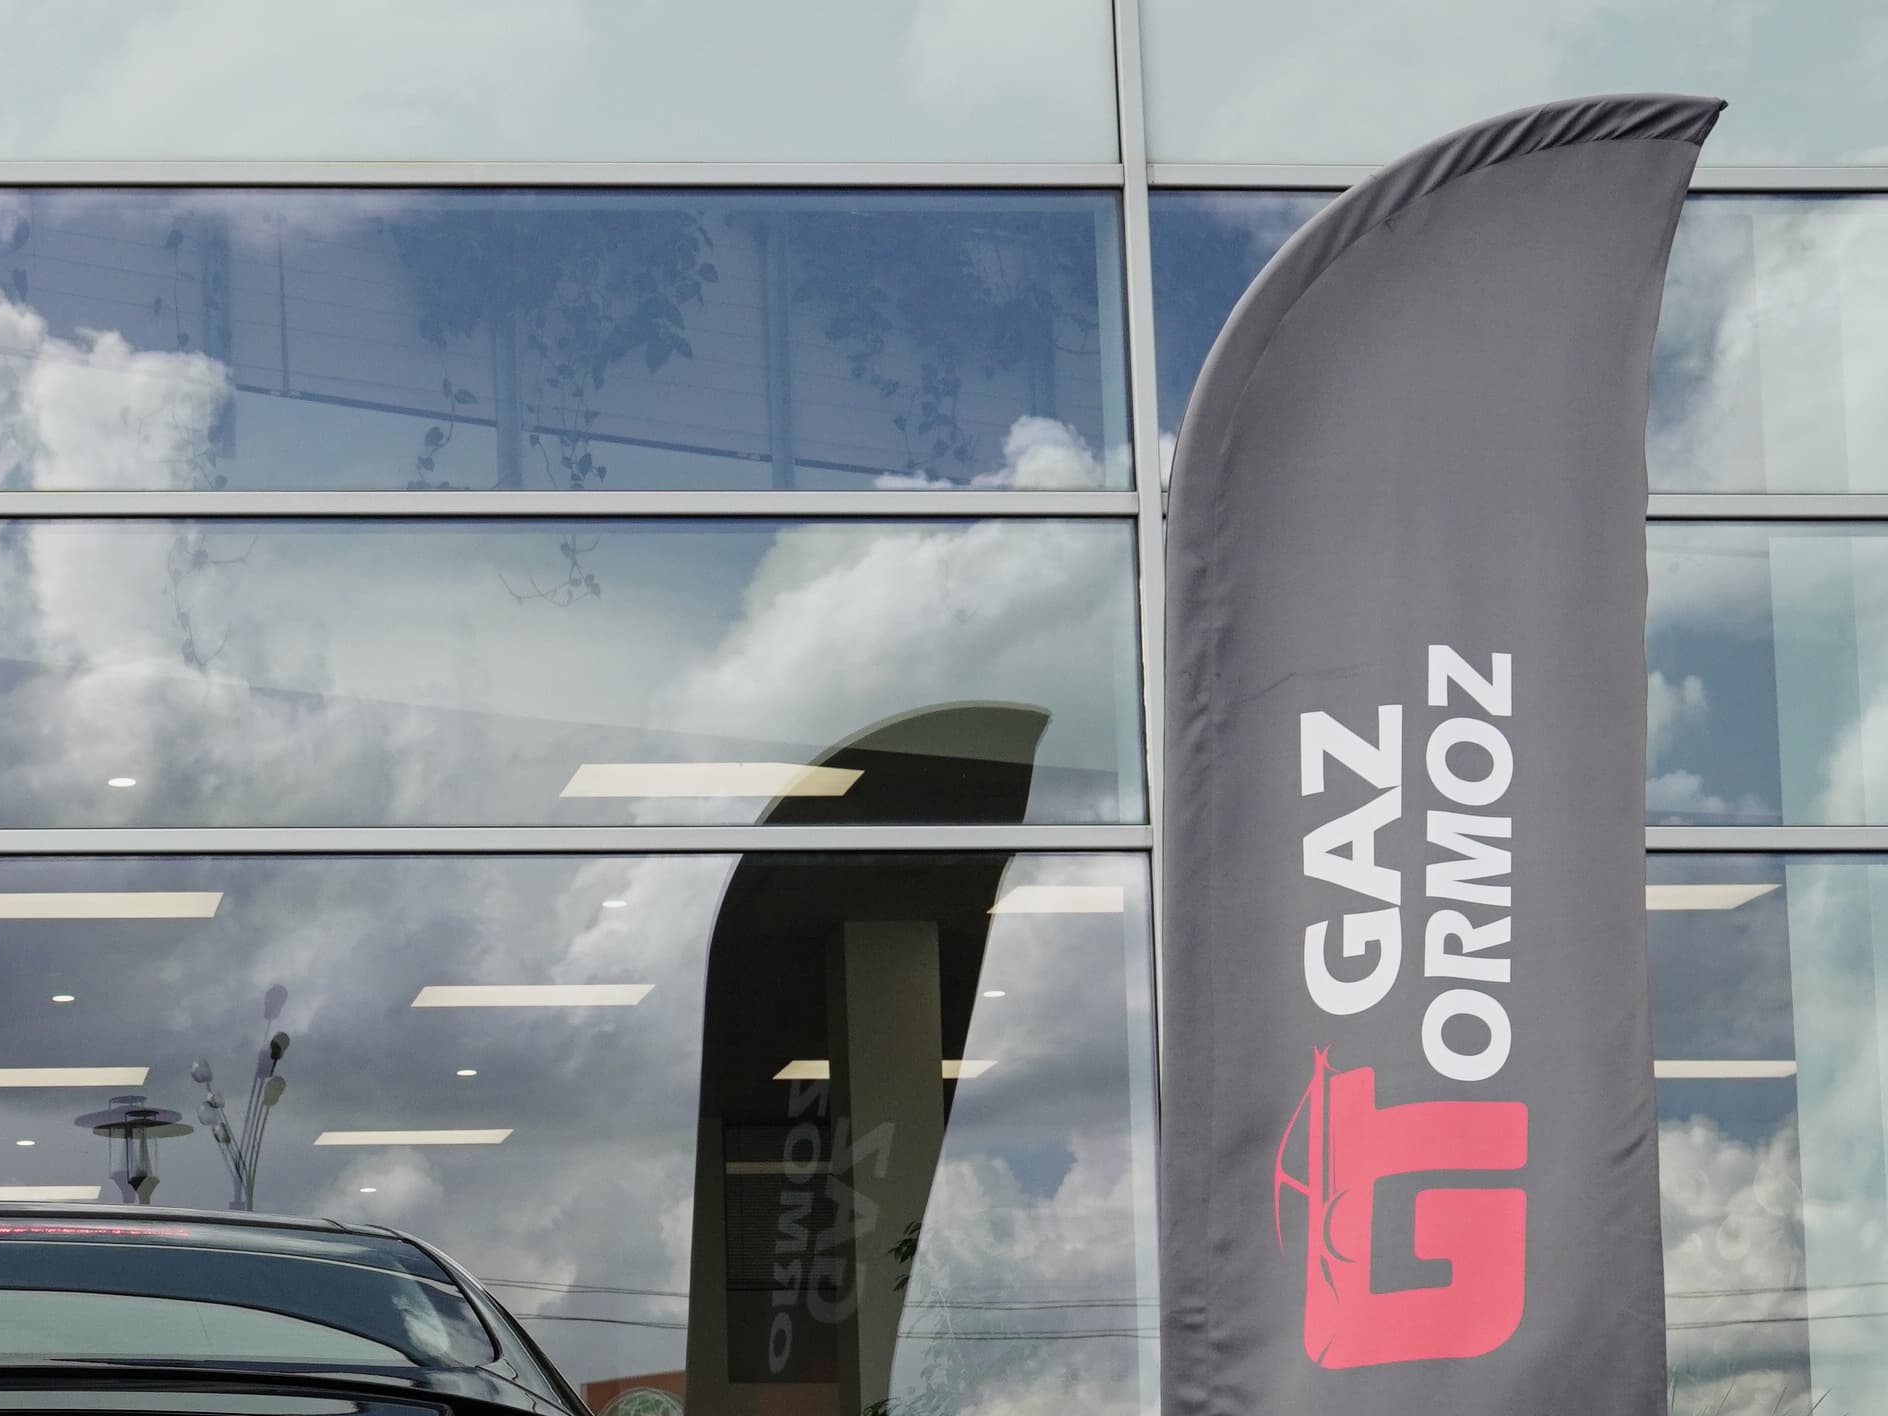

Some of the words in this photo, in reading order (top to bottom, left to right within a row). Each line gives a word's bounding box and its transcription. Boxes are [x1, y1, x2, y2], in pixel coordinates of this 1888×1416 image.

[1300, 704, 1403, 1016] GAZ
[1422, 644, 1514, 1081] ORMOZ
[1300, 1050, 1528, 1369] GT
